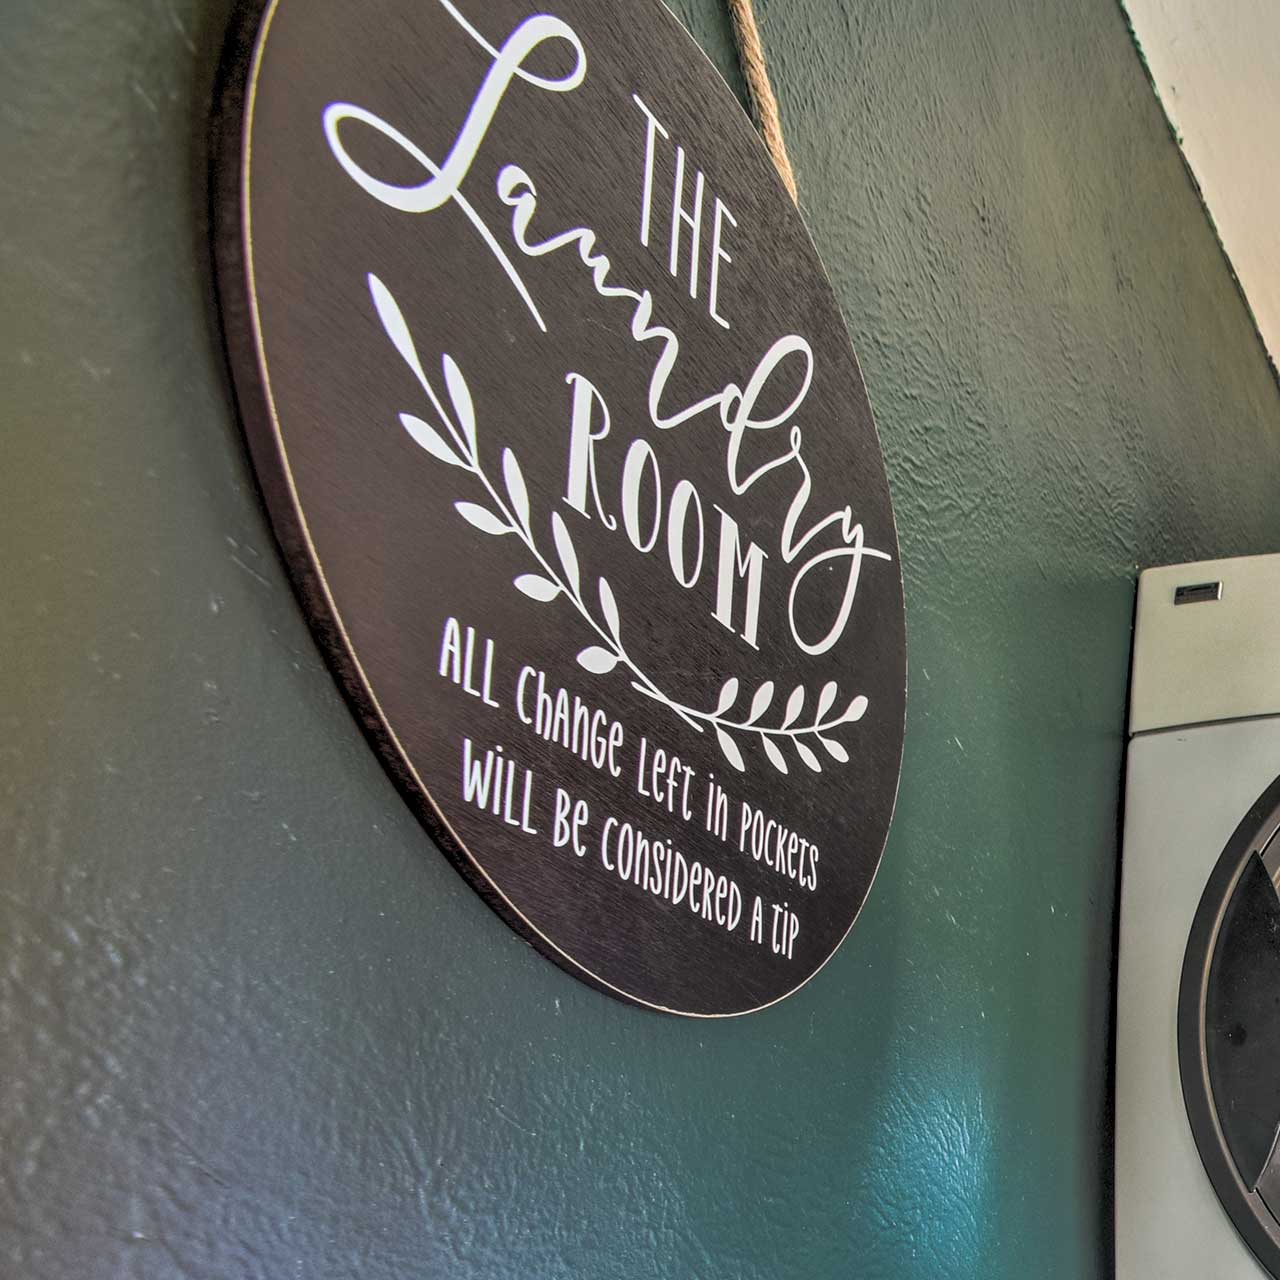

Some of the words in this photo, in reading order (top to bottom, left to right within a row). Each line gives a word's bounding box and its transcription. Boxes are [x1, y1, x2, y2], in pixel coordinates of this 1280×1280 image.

[323, 0, 892, 655] Laundry
[632, 93, 738, 329] THE
[562, 371, 768, 651] ROOM
[439, 617, 499, 708] ALL
[751, 896, 764, 943] A
